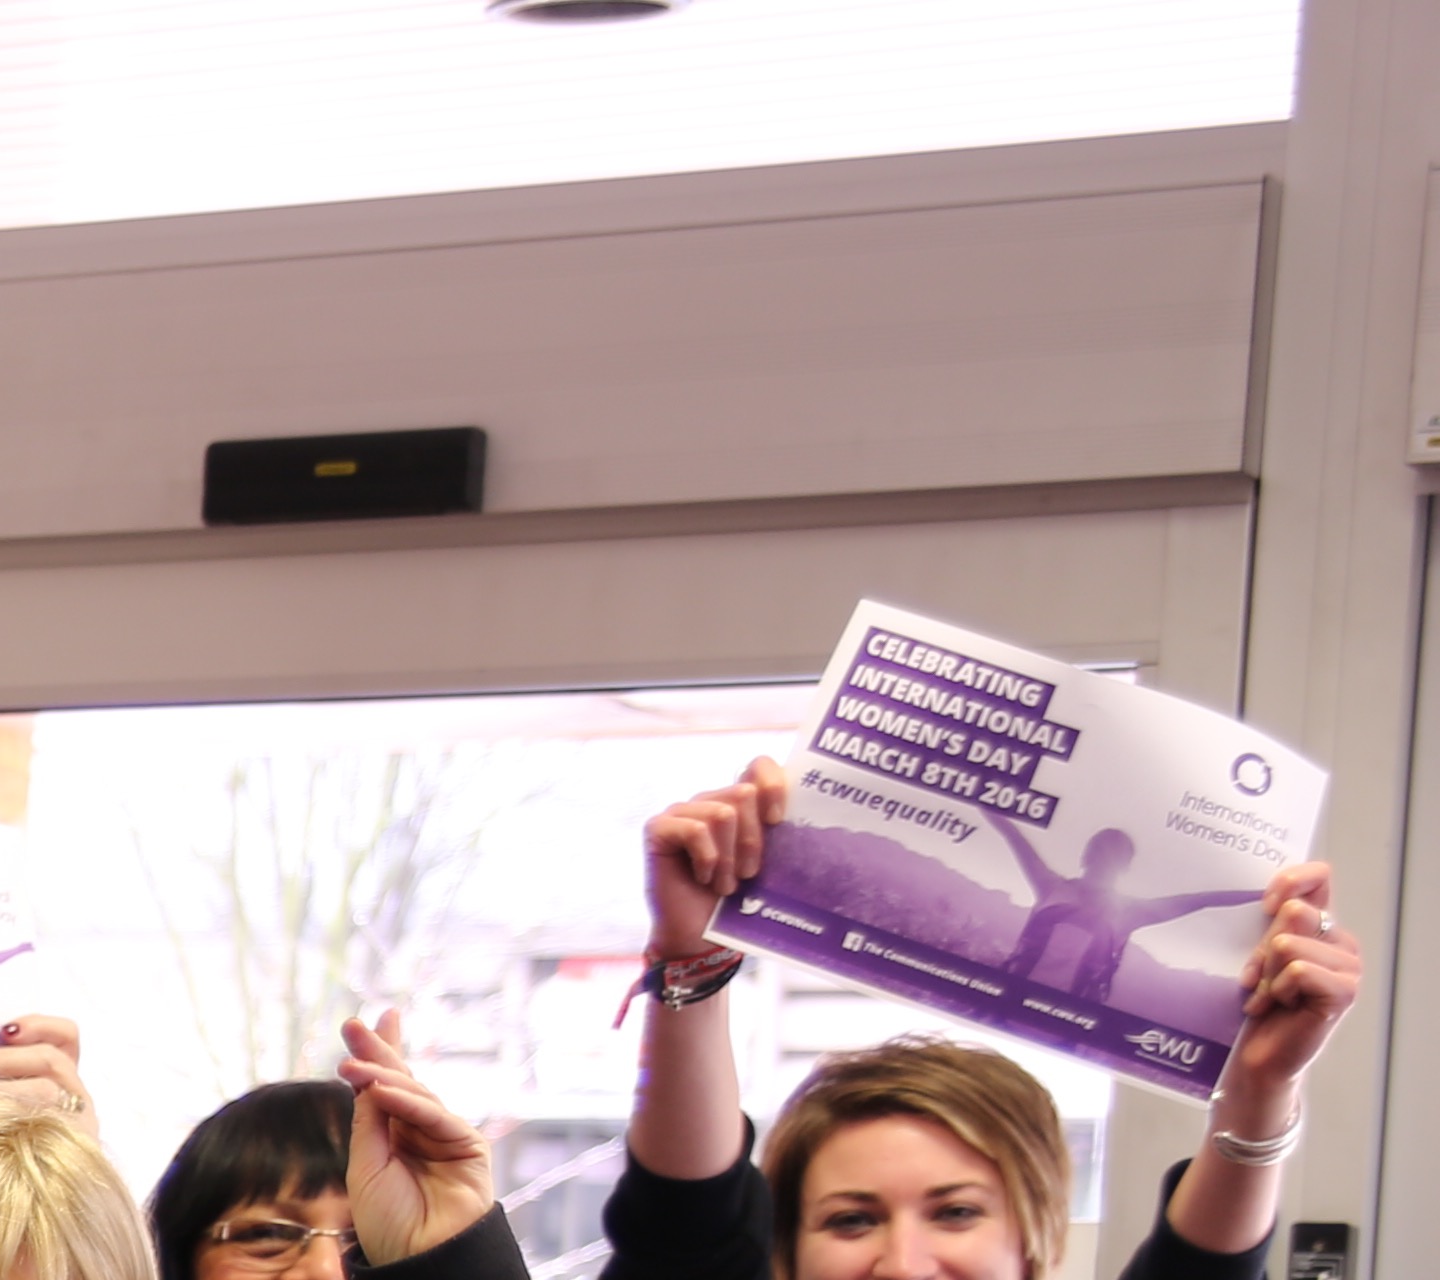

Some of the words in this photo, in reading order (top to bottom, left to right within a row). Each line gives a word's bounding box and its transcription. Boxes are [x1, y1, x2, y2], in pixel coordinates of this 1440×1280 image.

[867, 632, 1042, 708] CELEBRATING
[850, 665, 1069, 755] INTERNATIONAL
[818, 728, 921, 783] MARCH
[921, 763, 980, 797] 8TH
[979, 779, 1050, 820] 2016
[965, 737, 1031, 776] DAY
[800, 768, 977, 842] #cwuequality
[1180, 790, 1288, 840] International
[1250, 834, 1288, 868] Day
